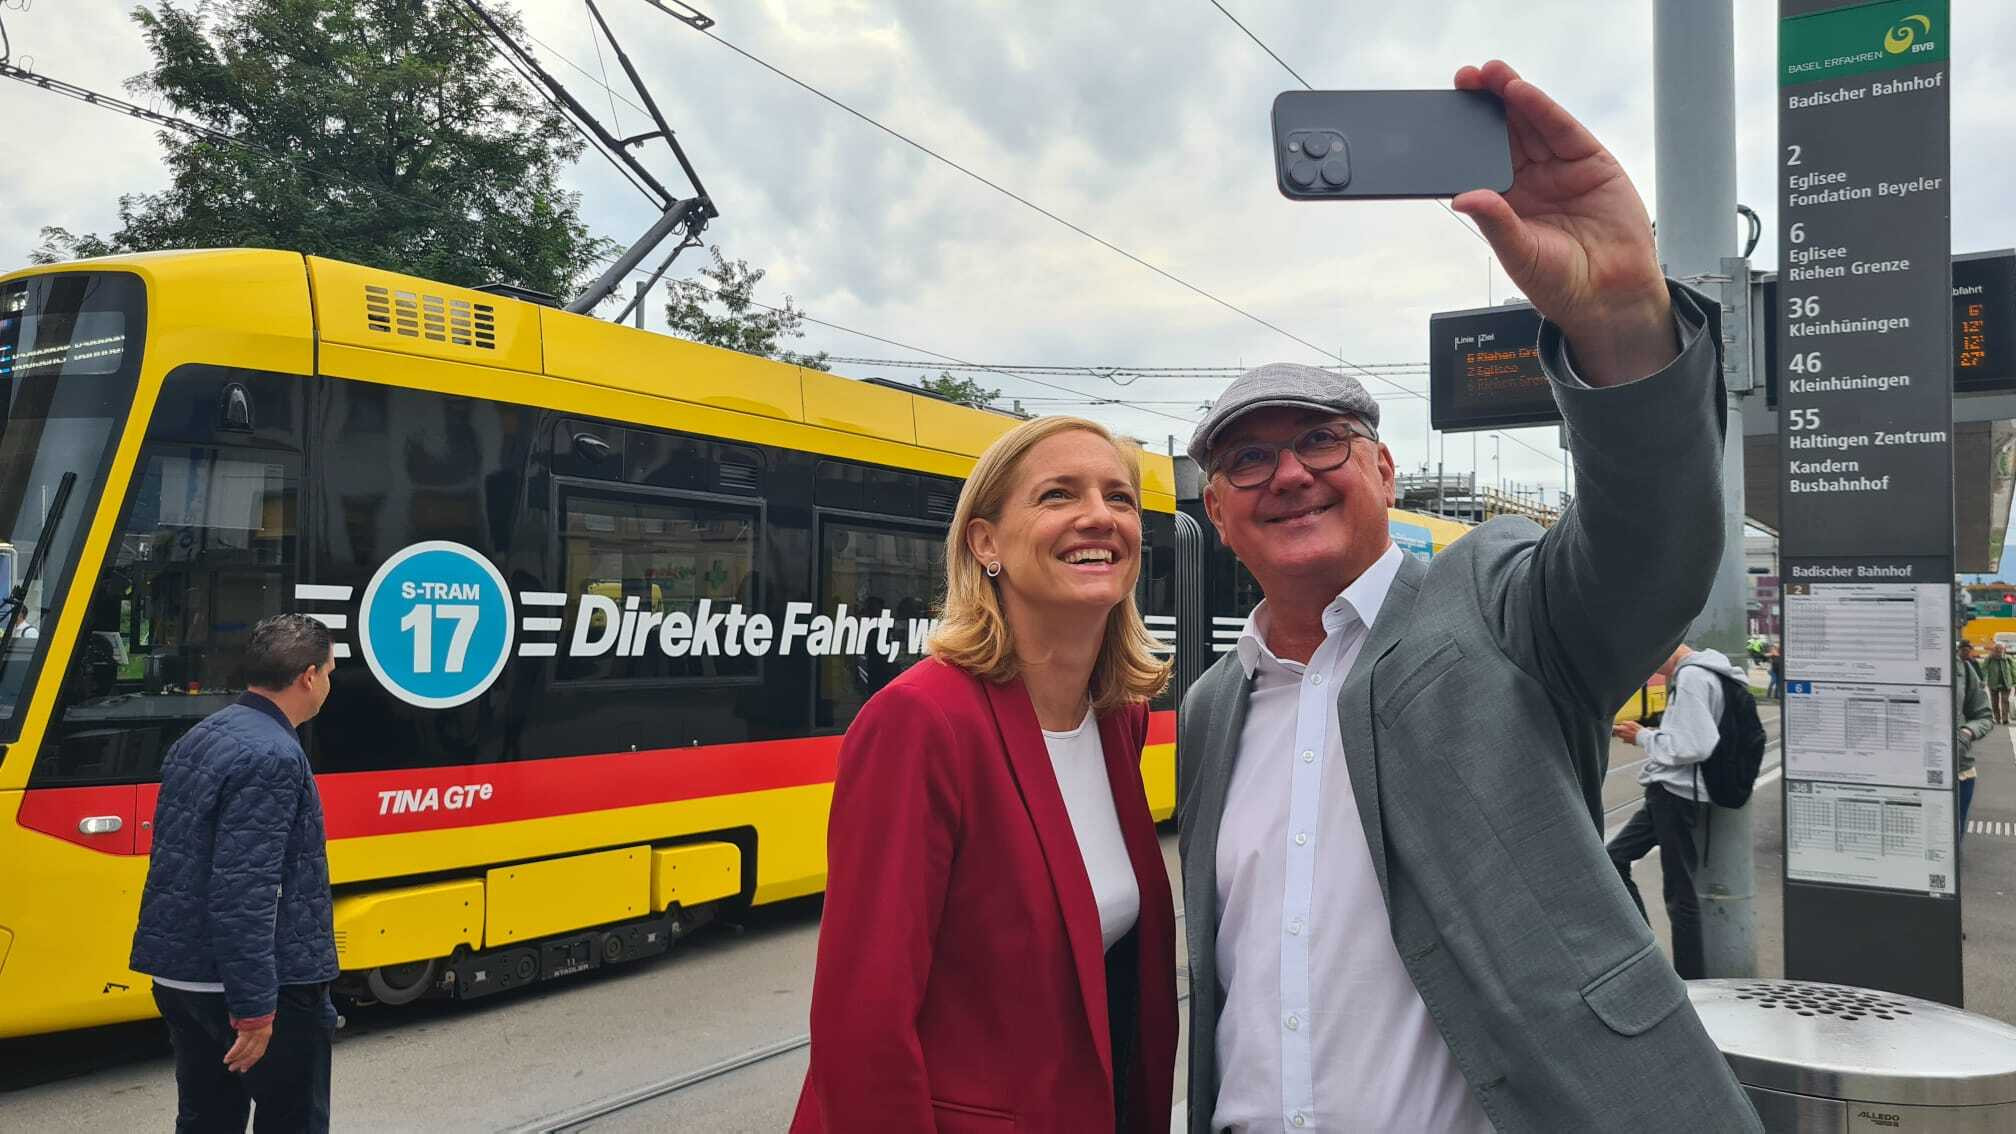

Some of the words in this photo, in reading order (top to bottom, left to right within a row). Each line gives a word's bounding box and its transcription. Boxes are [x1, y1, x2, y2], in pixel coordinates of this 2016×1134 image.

[1911, 42, 1935, 53] BVB
[1788, 62, 1822, 74] BASEL
[1824, 51, 1883, 68] ERFAHREN
[1789, 87, 1866, 110] Badischer
[1872, 72, 1943, 97] Bahnhof
[1787, 145, 1802, 166] 2
[1789, 171, 1847, 191] Eglisee
[1789, 186, 1872, 207] Fondation
[1878, 176, 1942, 197] Beyeler
[1790, 222, 1805, 243] 6
[1789, 246, 1847, 265] Eglisee
[1789, 265, 1845, 281] Riehen
[1851, 259, 1910, 275] Grenze
[1952, 286, 1982, 296] bfahrt
[1788, 295, 1820, 318] 36
[1789, 316, 1910, 337] Kleinhüningen
[1789, 352, 1822, 374] 46
[1789, 374, 1910, 393] Kleinhüningen
[1789, 408, 1821, 430] 55
[1789, 434, 1869, 450] Haltingen
[1874, 430, 1947, 445] Zentrum
[1789, 459, 1859, 474] Kandern
[1789, 475, 1890, 493] Busbahnhof
[1792, 566, 1853, 577] Badischer
[1857, 565, 1912, 577] Bahnhof
[402, 582, 480, 600] S-TRAM
[1794, 585, 1802, 594] 2
[401, 604, 480, 673] 17
[569, 594, 773, 657] Direkte
[779, 602, 900, 663] Fahrt,
[378, 788, 439, 815] TINA
[1857, 1111, 1900, 1121] ALLEDO
